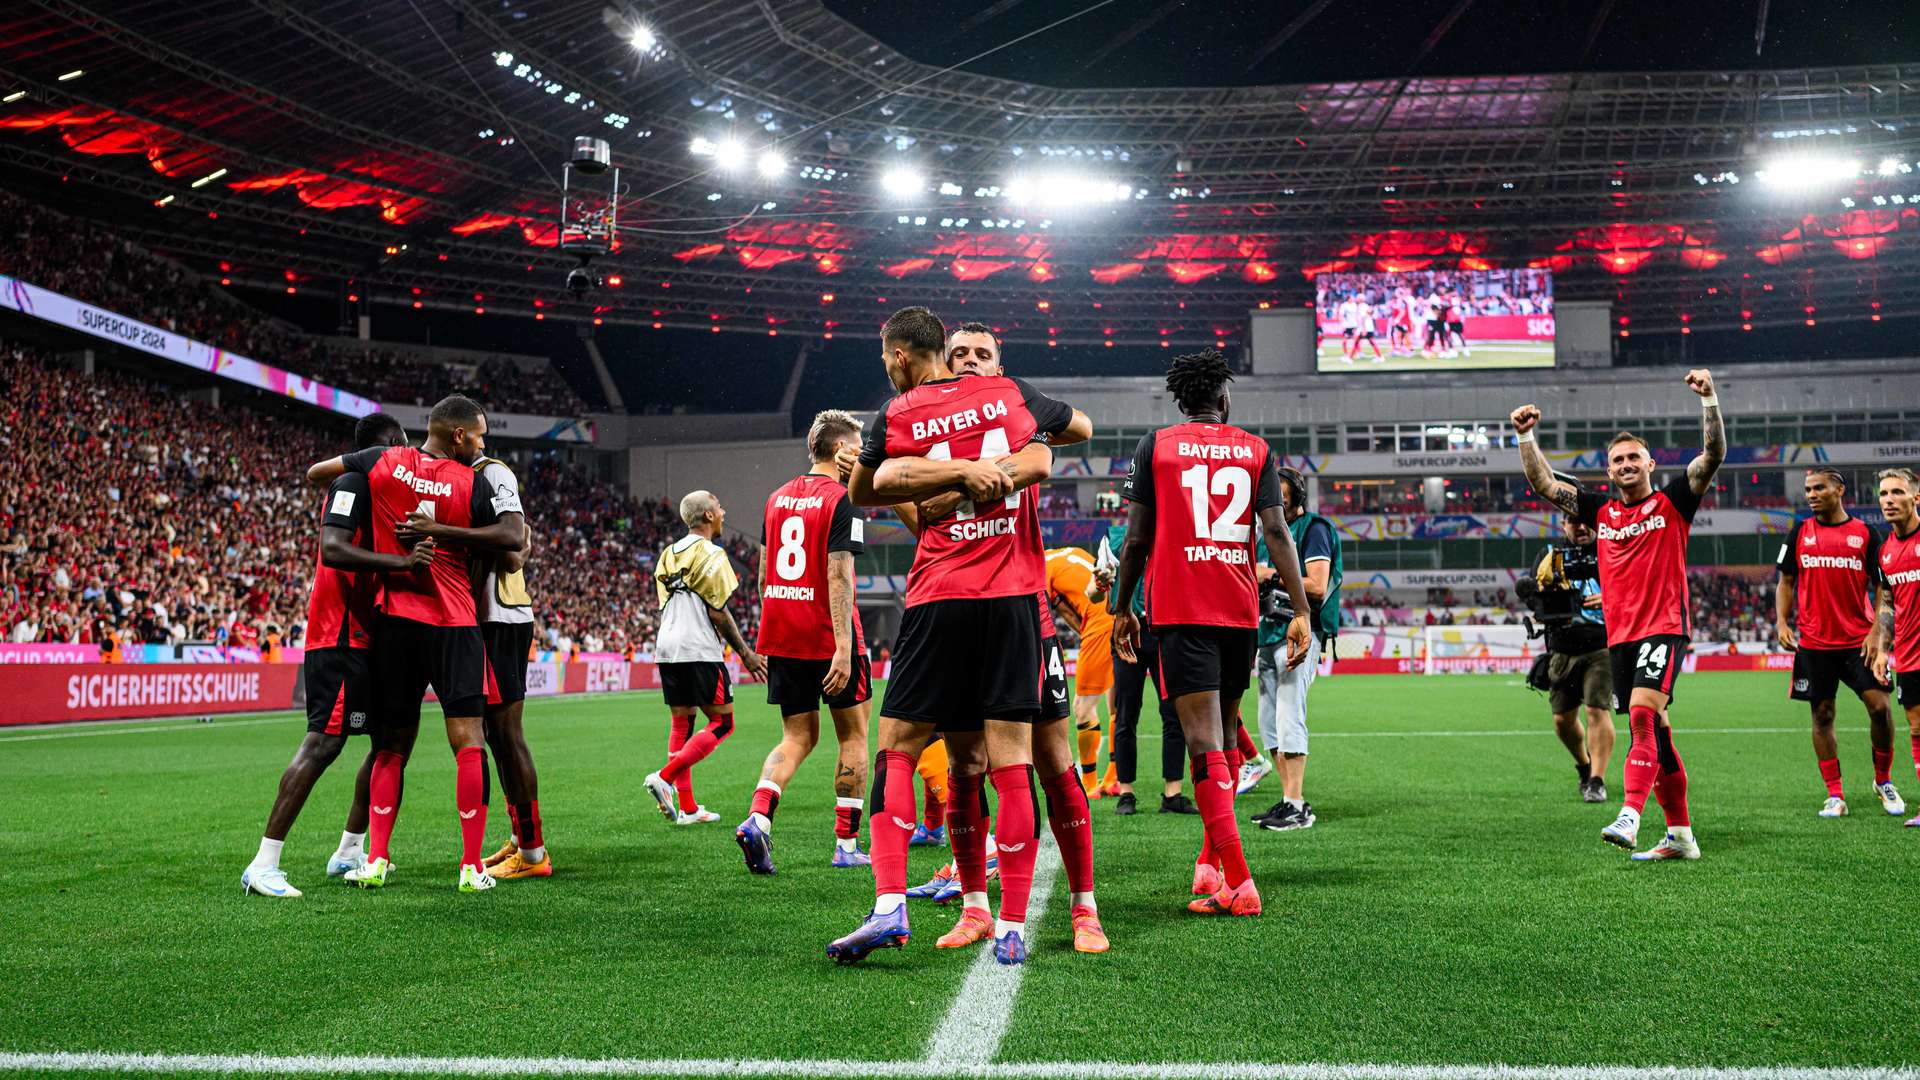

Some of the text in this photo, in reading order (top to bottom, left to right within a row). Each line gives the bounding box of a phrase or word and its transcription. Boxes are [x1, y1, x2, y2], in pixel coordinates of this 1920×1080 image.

[82, 310, 139, 340] SUPERCUP
[141, 330, 165, 351] 2024
[912, 400, 1008, 440] BAYER 04
[1178, 443, 1253, 459] BAYER 04
[1397, 456, 1487, 467] SUPERCUP 2024
[1181, 464, 1251, 543] 12
[950, 516, 1017, 542] SCHICK
[1598, 514, 1666, 541] Barmenia
[776, 516, 806, 580] 8
[1184, 546, 1249, 565] TAPSOBA
[1800, 553, 1863, 572] Barmenia
[1407, 573, 1496, 586] SUPERCUP 2024
[764, 585, 814, 601] ANDRICH
[1045, 646, 1064, 680] 4
[1637, 642, 1668, 669] 24
[66, 672, 260, 709] SICHERHEITSSCHUHE
[1630, 759, 1652, 768] B04
